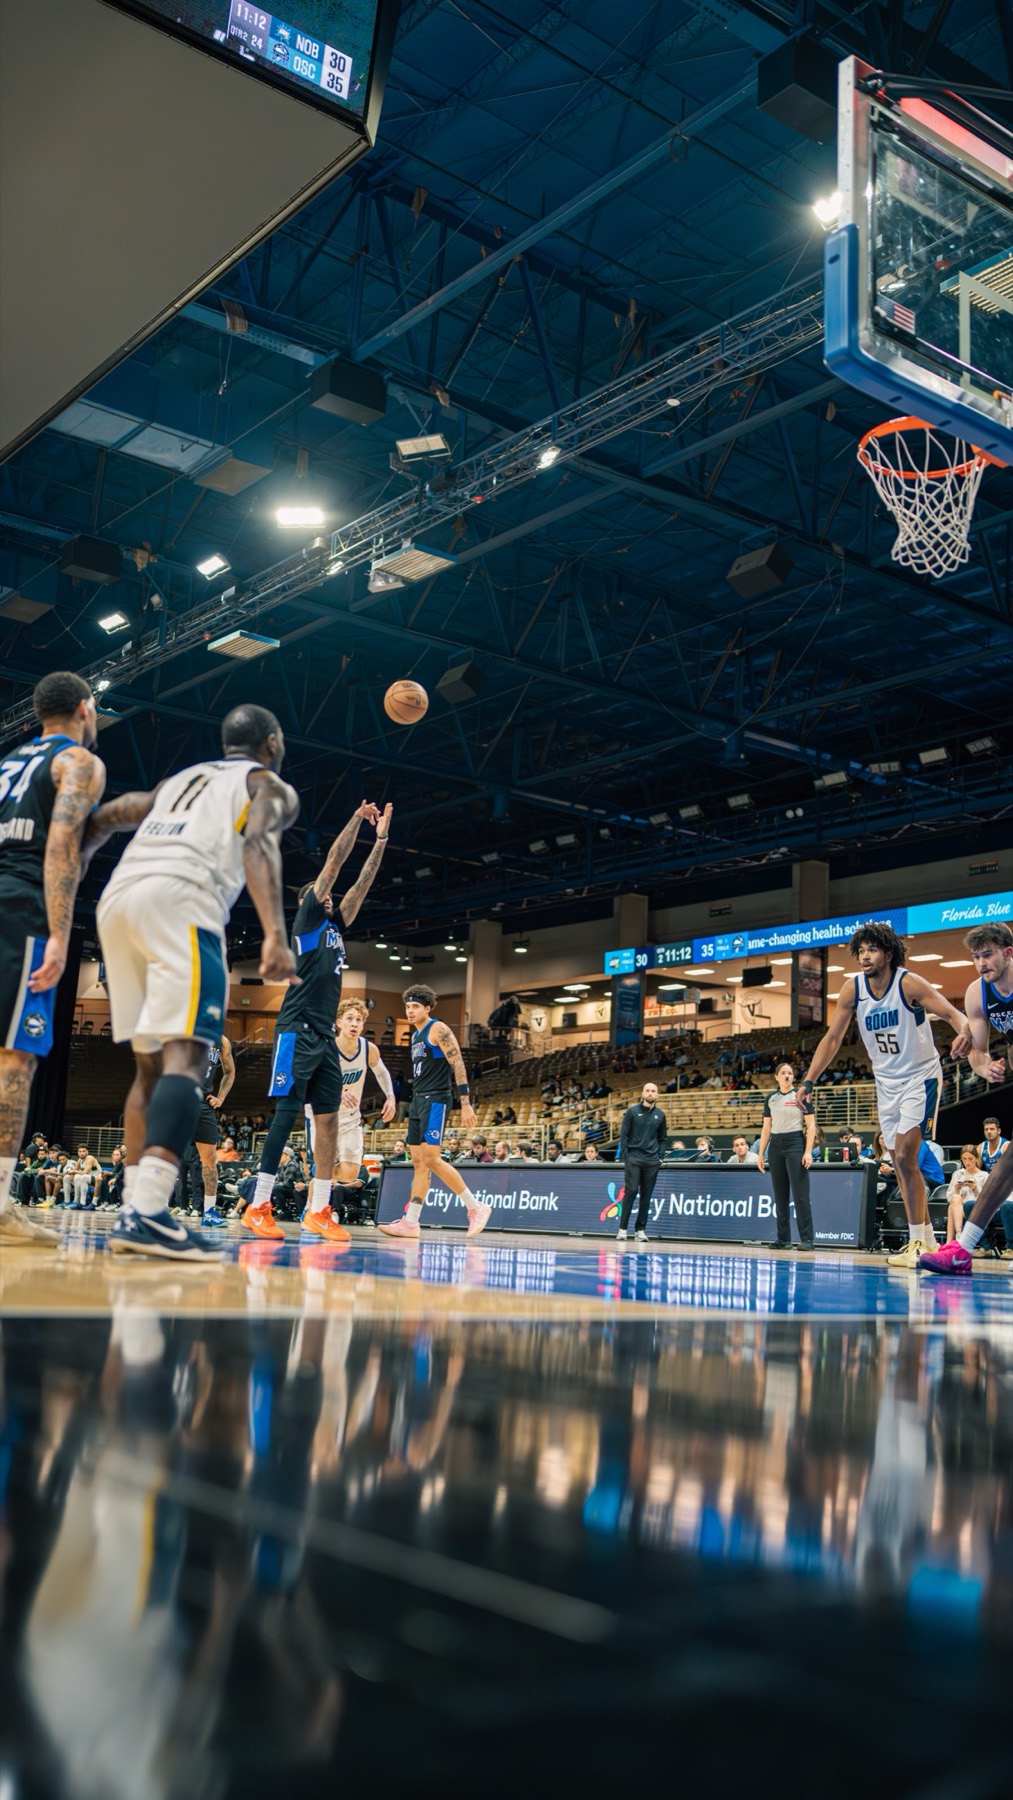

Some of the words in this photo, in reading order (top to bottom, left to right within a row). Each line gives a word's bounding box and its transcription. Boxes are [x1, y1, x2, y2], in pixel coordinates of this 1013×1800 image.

[237, 4, 267, 30] 11:12
[251, 35, 263, 49] 24
[296, 34, 320, 59] NOB
[330, 51, 346, 73] 30
[293, 55, 316, 79] OSC
[327, 72, 343, 93] 35
[0, 754, 45, 803] 34
[170, 774, 210, 813] 11
[942, 905, 984, 922] Florida
[986, 901, 1011, 917] Blue
[812, 923, 843, 940] health
[636, 953, 648, 967] 30
[657, 954, 664, 964] 2
[665, 946, 692, 962] 11:12
[701, 943, 714, 957] 35
[865, 1009, 899, 1031] BOOM
[990, 1010, 1013, 1018] OSCE
[875, 1033, 900, 1055] 55
[425, 1188, 454, 1213] City
[519, 1190, 559, 1212] Bank
[669, 1193, 753, 1218] National
[815, 1231, 840, 1240] Member
[840, 1232, 855, 1240] FDIC
